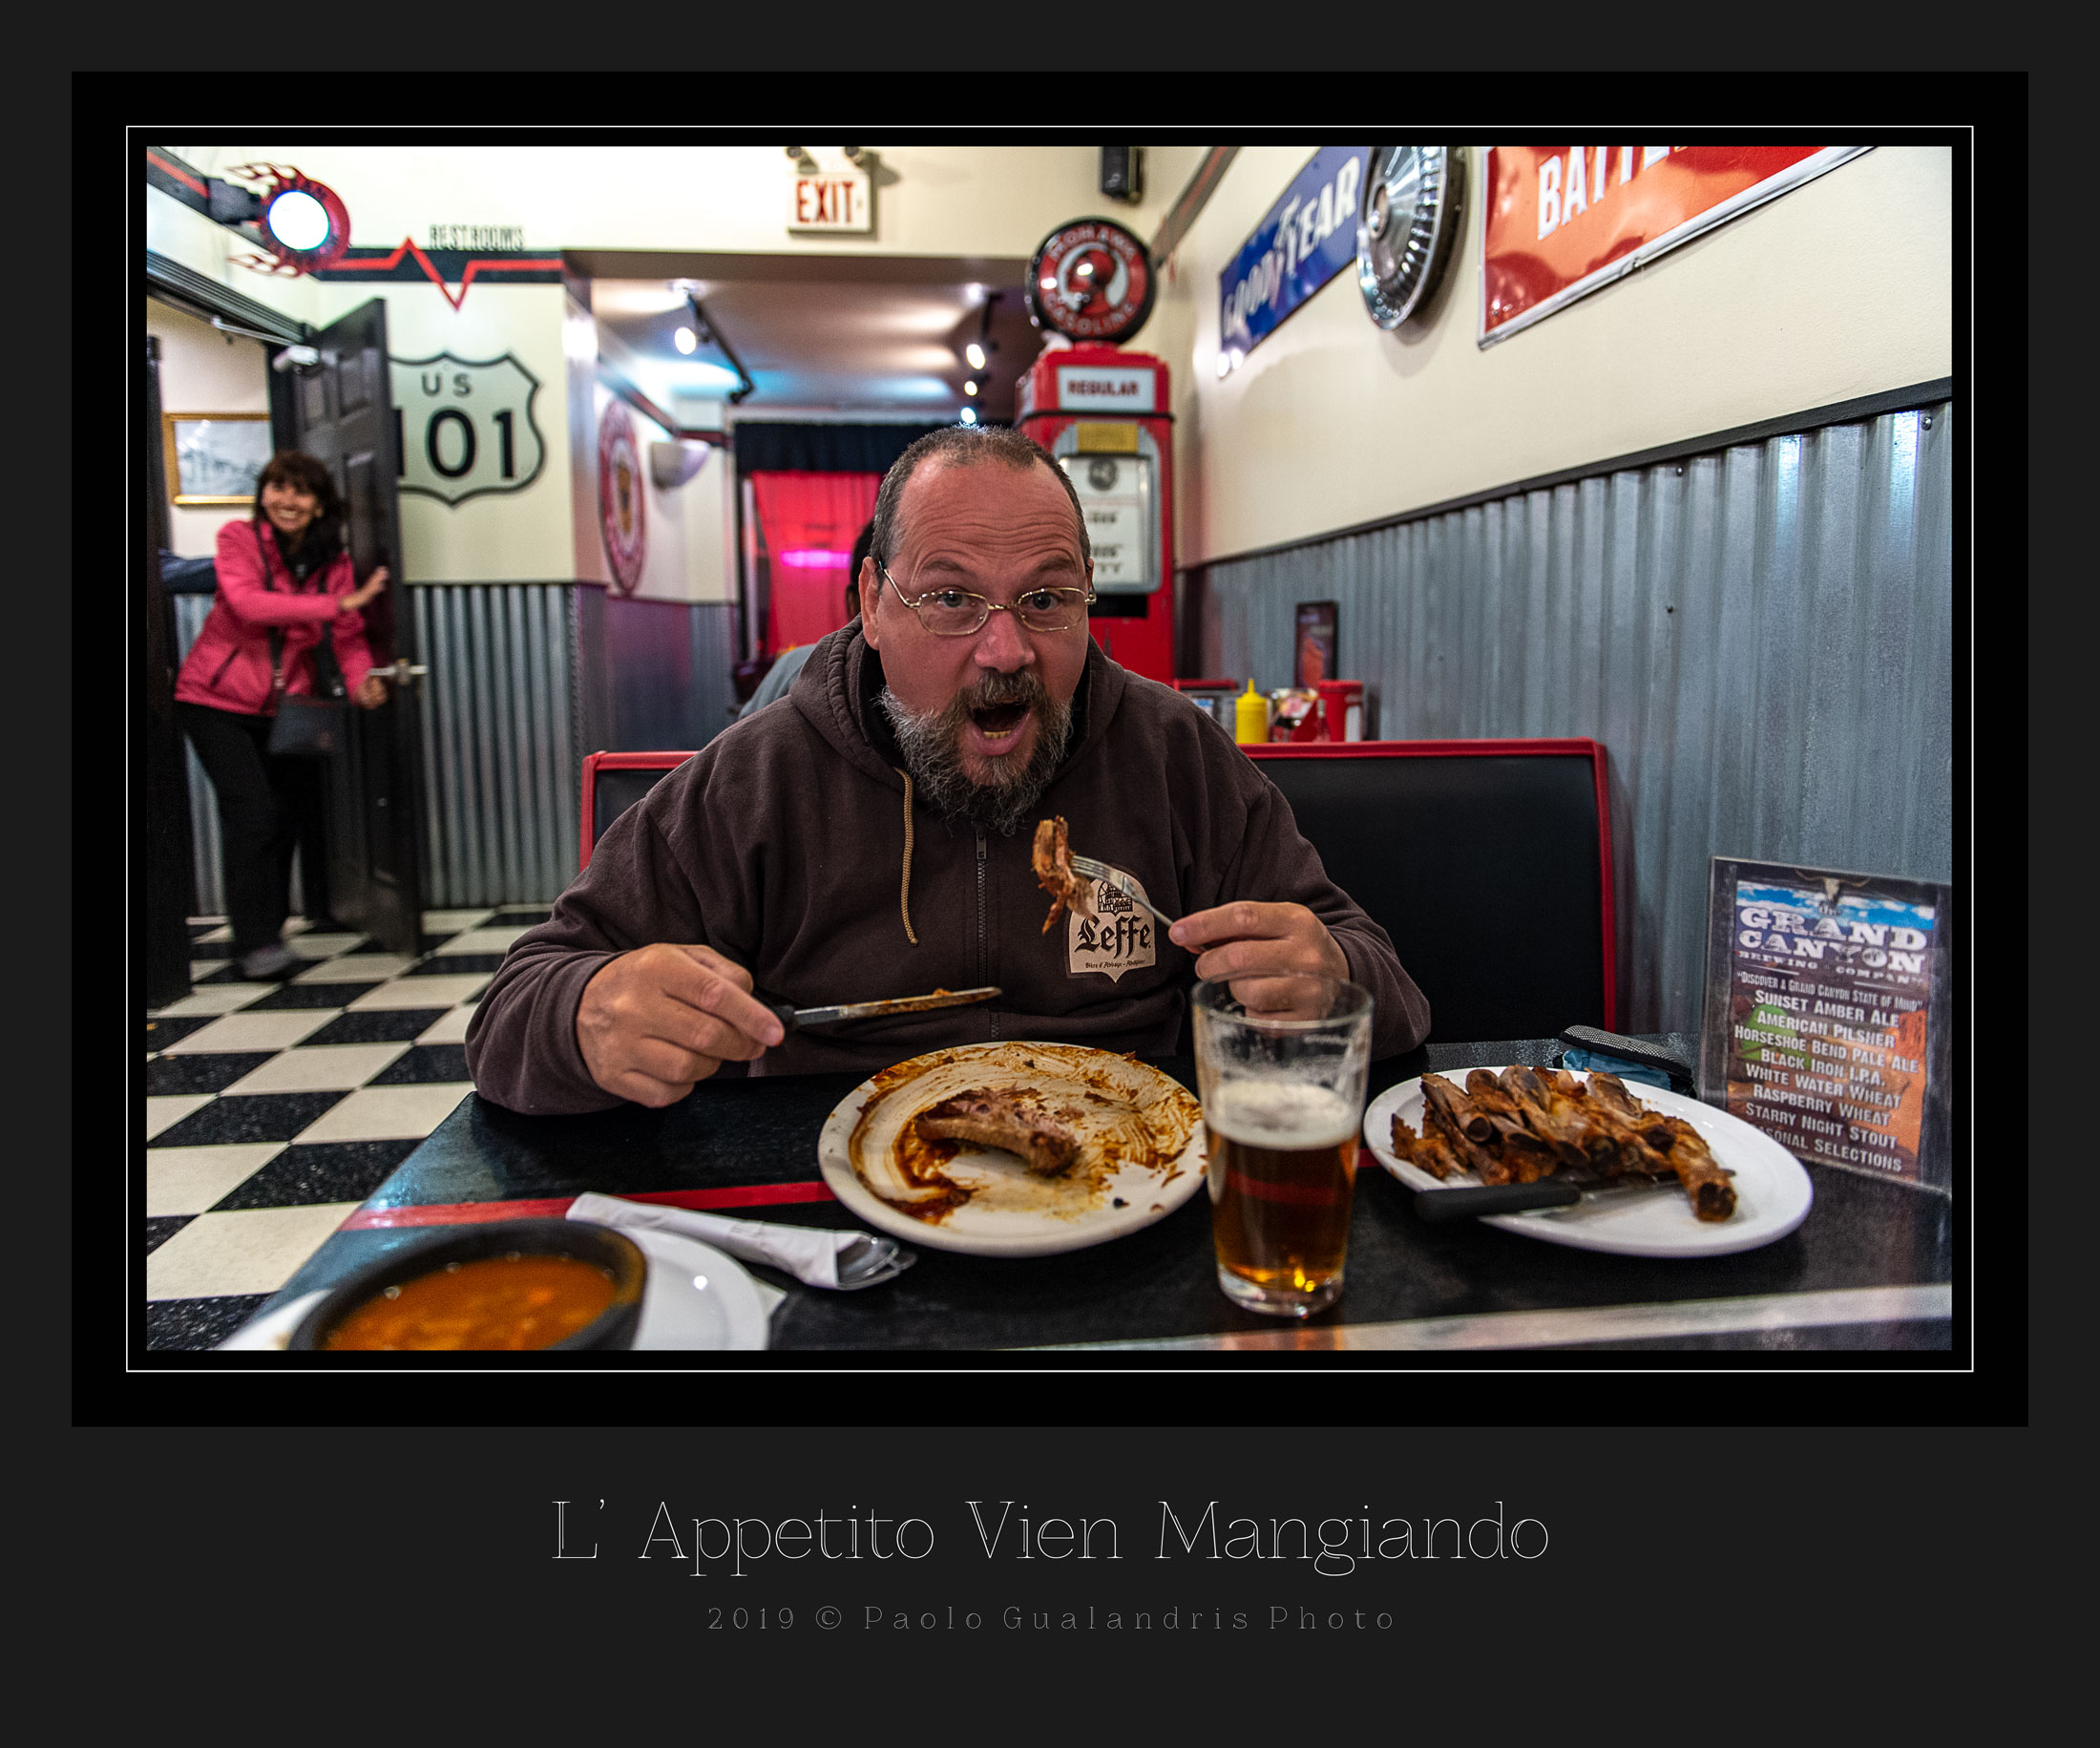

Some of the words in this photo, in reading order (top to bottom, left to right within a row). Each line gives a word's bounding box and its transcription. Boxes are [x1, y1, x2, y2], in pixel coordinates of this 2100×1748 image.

[796, 179, 854, 222] EXIT
[1538, 146, 1688, 241] BATT
[430, 224, 524, 250] RESTROOMS
[1043, 291, 1135, 334] GASOLINE
[1067, 380, 1139, 397] REGULAR
[1739, 907, 1927, 951] GRAND
[1738, 930, 1925, 974] CANYON
[1739, 951, 1818, 969] BREWING
[1754, 989, 1808, 1011] SUNSET
[1815, 1000, 1865, 1021] AMBER
[1871, 1010, 1900, 1027] ALE
[1788, 979, 1816, 995] GRAND
[1817, 983, 1850, 1000] CANYON
[1853, 987, 1878, 1004] STATE
[1880, 995, 1892, 1008] OF
[1734, 1024, 1807, 1052] HORSESHOE
[1812, 1039, 1847, 1060] BEND
[1852, 1048, 1886, 1067] PALE
[1892, 1058, 1919, 1074] ALE
[1757, 1010, 1828, 1036] AMERICAN
[1834, 1023, 1896, 1048] PILSNER
[1746, 1064, 1789, 1085] WHITE
[1795, 1074, 1843, 1097] WATER
[1850, 1085, 1902, 1108] WHEAT
[1761, 1049, 1805, 1070] BLACK
[1812, 1059, 1844, 1078] IRON
[1849, 1066, 1886, 1087] I.P.A.
[1746, 1102, 1797, 1127] STARRY
[1801, 1115, 1844, 1137] NIGHT
[1849, 1127, 1898, 1150] STOUT
[1754, 1085, 1834, 1114] RASPBERRY
[1839, 1102, 1892, 1127] WHEAT
[1814, 1139, 1902, 1172] SELECTIONS
